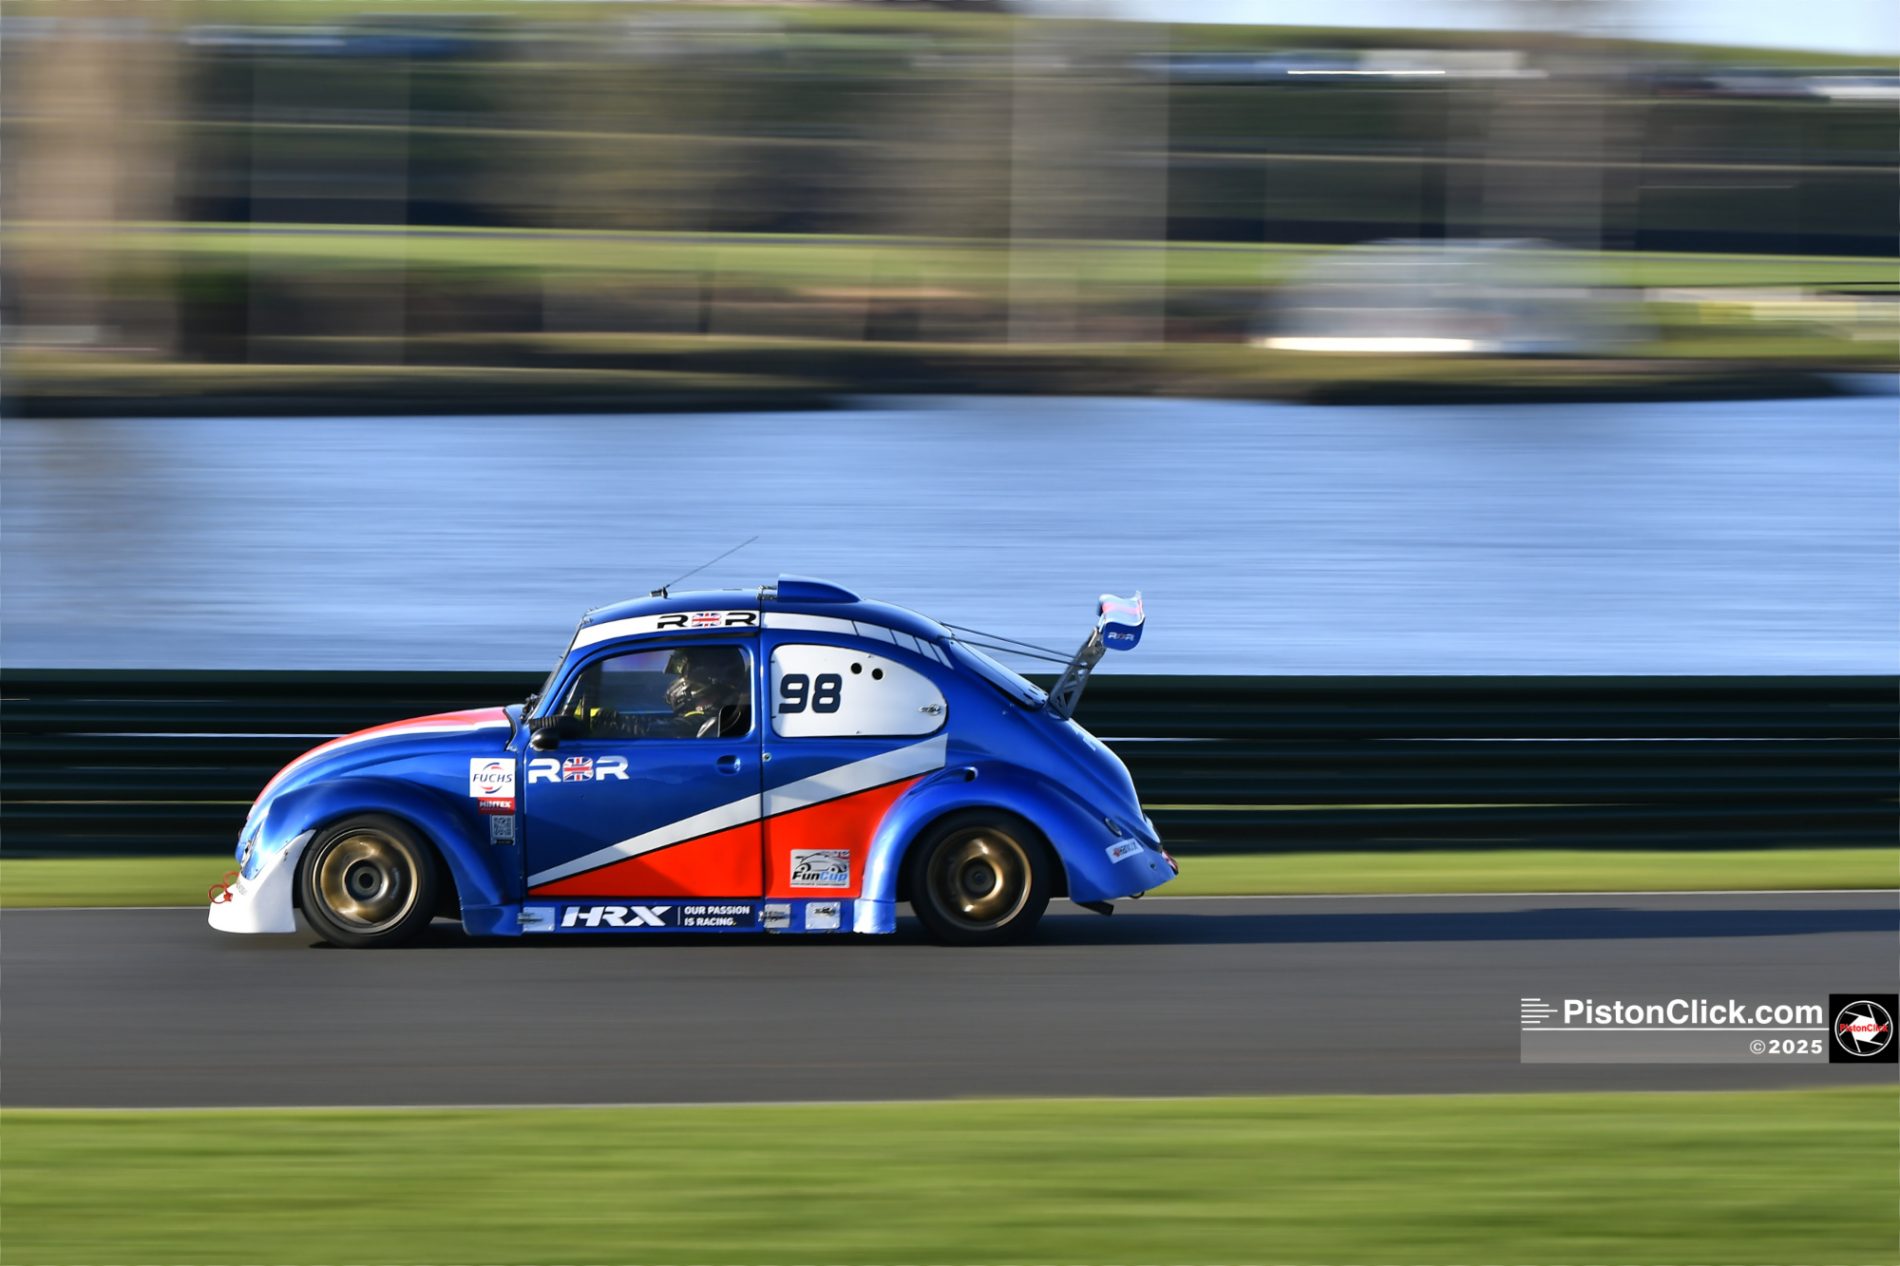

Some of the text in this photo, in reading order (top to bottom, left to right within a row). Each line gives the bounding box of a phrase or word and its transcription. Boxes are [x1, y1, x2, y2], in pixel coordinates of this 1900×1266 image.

[778, 673, 842, 714] 98
[528, 755, 629, 783] RBR
[472, 773, 513, 784] FUCHS
[479, 800, 512, 809] MINTEX
[684, 906, 750, 915] OUR PASSION
[560, 906, 673, 927] HRX
[684, 917, 736, 927] IS RACING.
